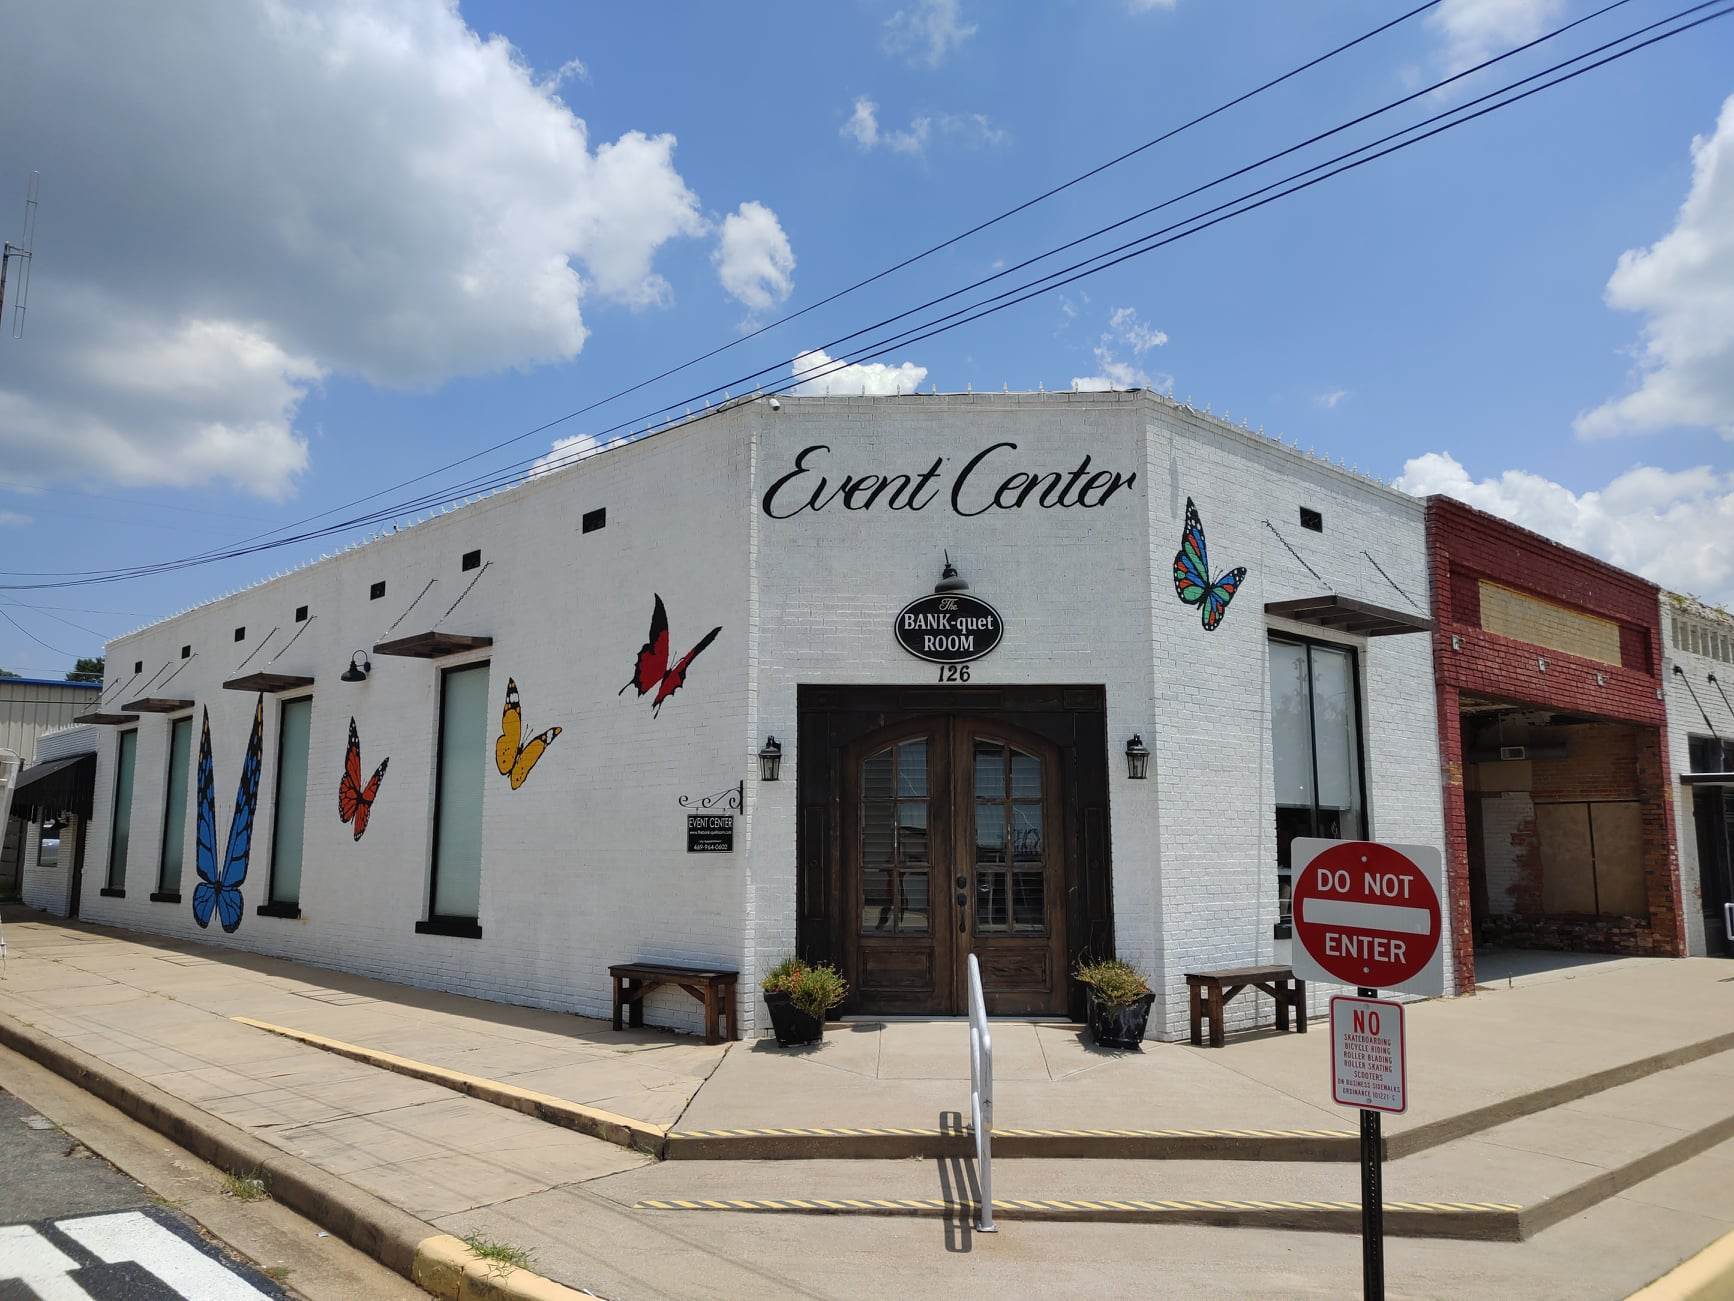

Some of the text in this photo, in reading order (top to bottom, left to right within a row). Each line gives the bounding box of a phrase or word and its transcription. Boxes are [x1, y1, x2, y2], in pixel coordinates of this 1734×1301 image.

[762, 442, 1137, 519] Event Center
[939, 598, 959, 611] The
[904, 613, 994, 634] BANK-quet
[924, 635, 974, 651] ROOM
[938, 665, 970, 682] 126
[689, 817, 732, 828] EVENT CENTER
[1317, 868, 1414, 899] DO NOT
[1325, 932, 1407, 964] ENTER
[1353, 1009, 1380, 1036] NO
[1344, 1034, 1391, 1046] SKATEBOARDING
[1345, 1042, 1391, 1055] BICYCLE RIDING
[1343, 1051, 1392, 1064] ROLLER BLADING
[1343, 1060, 1392, 1073] ROLLER SKATING
[1354, 1070, 1383, 1081] SCOOTERS
[1342, 1087, 1371, 1097] ORDINANCE
[1346, 1079, 1370, 1088] BUSINESS
[1372, 1083, 1400, 1093] SIDEWALKS
